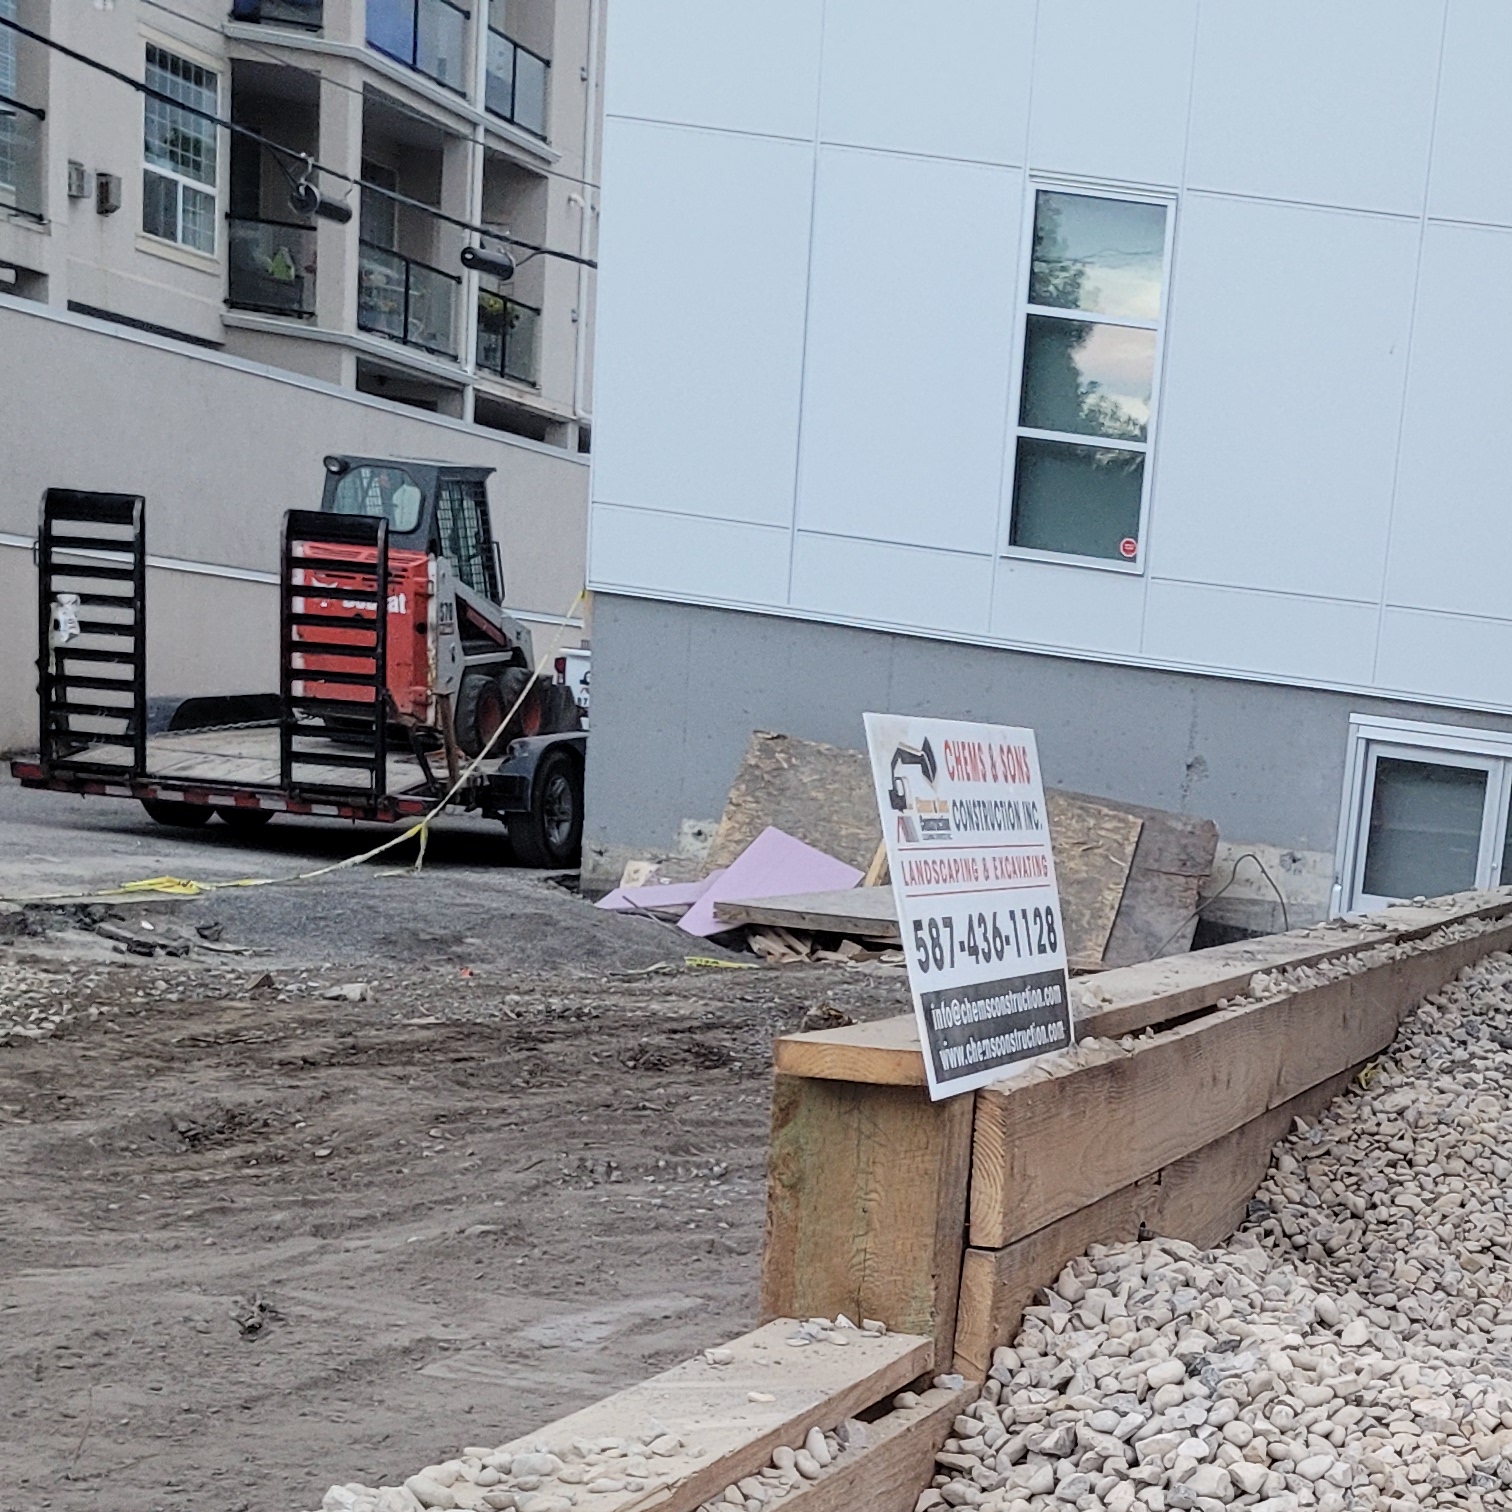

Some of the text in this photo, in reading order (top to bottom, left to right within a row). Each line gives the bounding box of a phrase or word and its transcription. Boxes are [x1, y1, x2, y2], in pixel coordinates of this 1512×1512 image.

[944, 739, 1031, 785] CHEMS & SONS
[951, 799, 1022, 832] CONSTRUCTION
[1022, 800, 1043, 831] INC.
[901, 854, 1048, 887] LANDSCAPING & EXCAVATING
[912, 905, 1058, 974] 587-436-1128
[931, 984, 1062, 1031] info@chemsconstruction.com
[939, 1020, 1065, 1071] www.chemsconstruction.com
